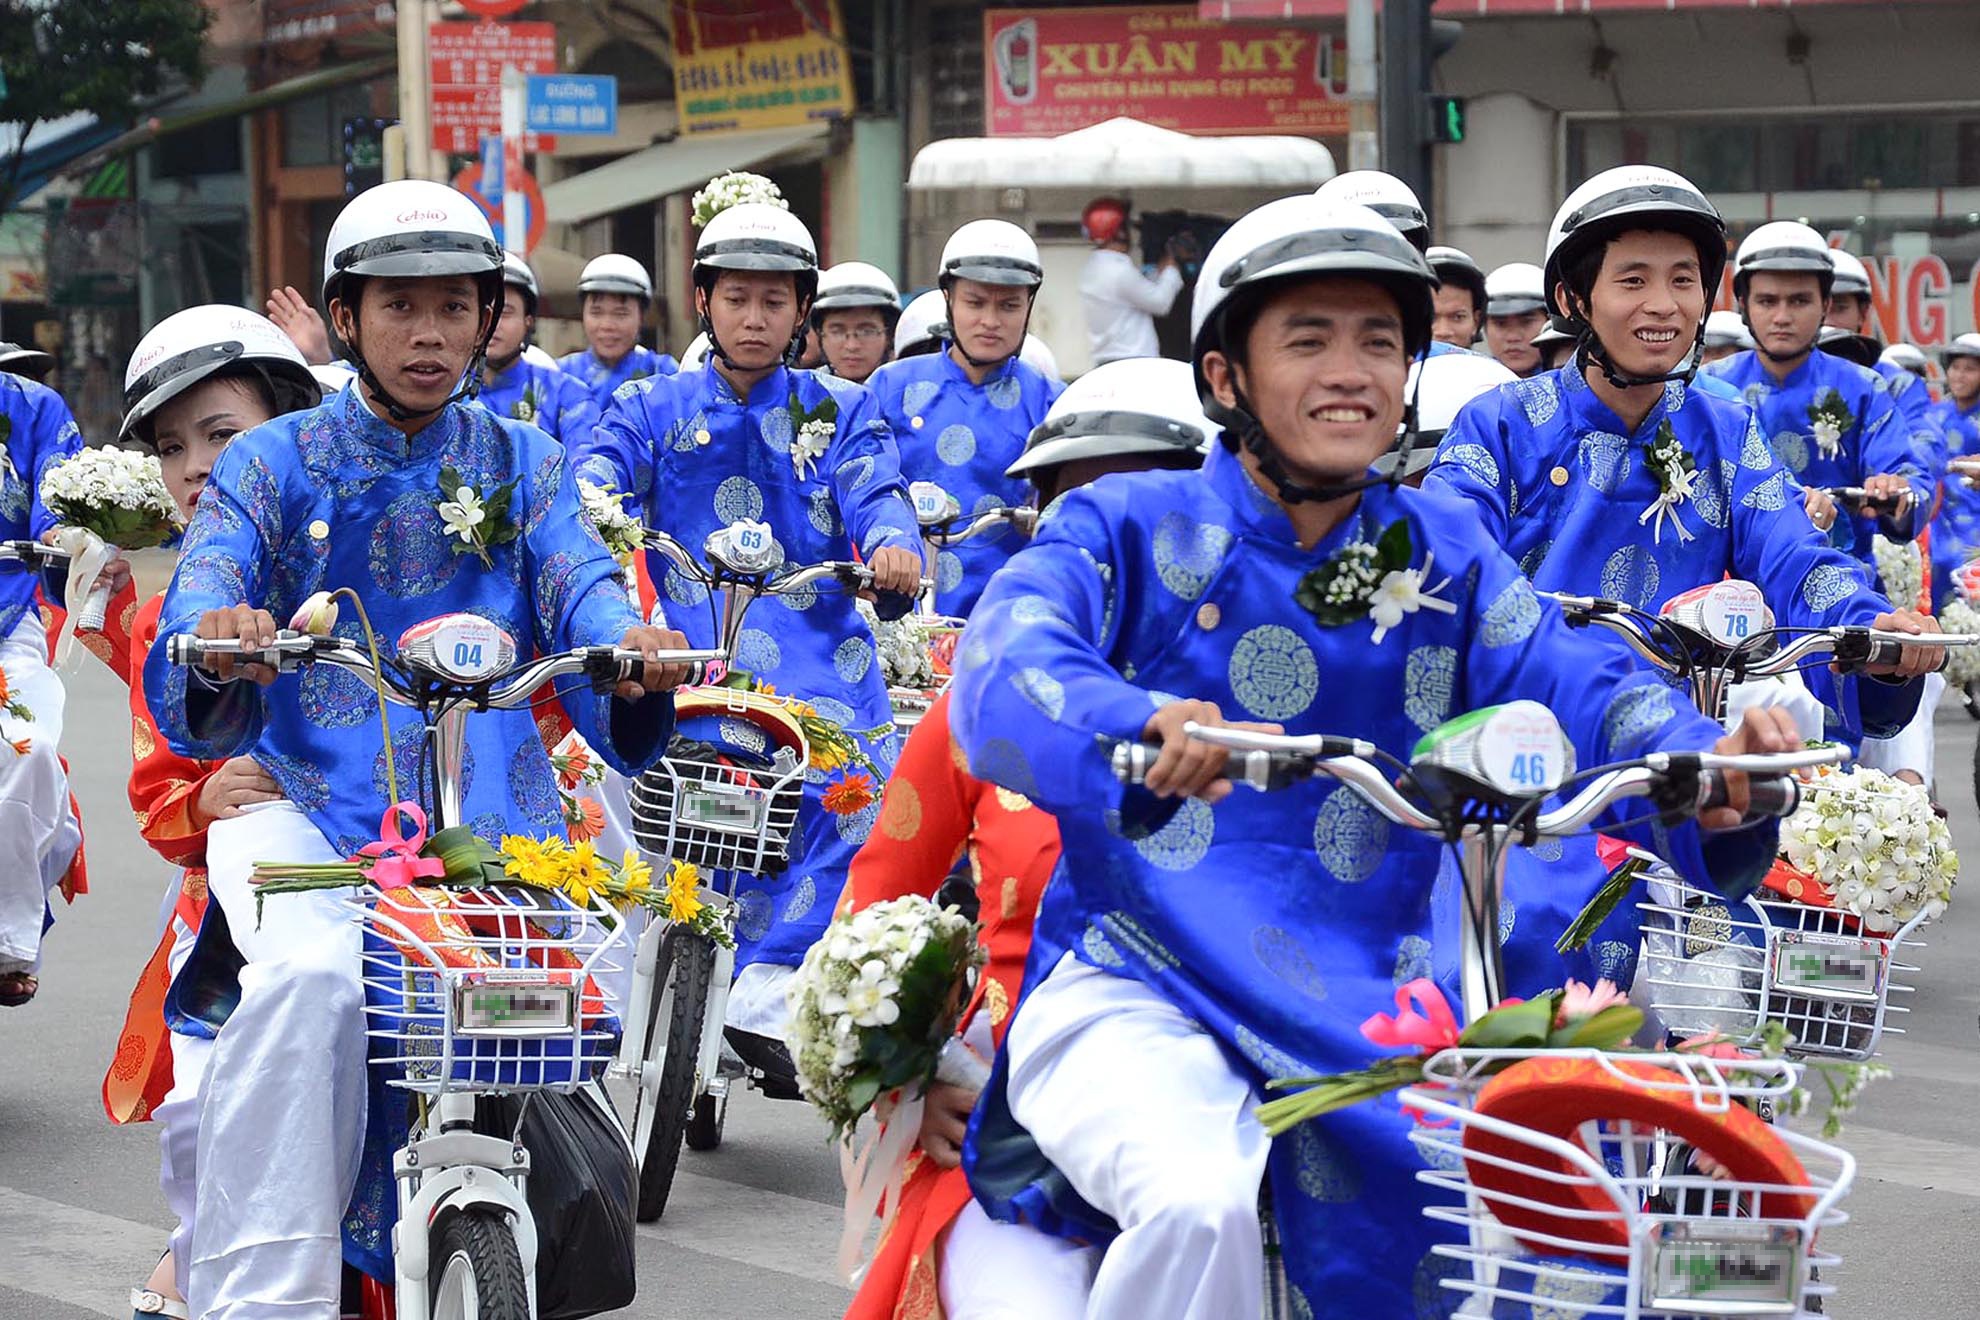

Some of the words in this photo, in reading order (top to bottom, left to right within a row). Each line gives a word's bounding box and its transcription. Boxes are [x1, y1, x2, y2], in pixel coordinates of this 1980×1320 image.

[1041, 34, 1198, 77] XUÂN
[1219, 31, 1306, 74] MỸ
[918, 496, 935, 512] 50
[740, 530, 762, 549] 63
[1723, 614, 1749, 638] 78
[453, 642, 482, 668] 04
[1509, 753, 1546, 786] 46
